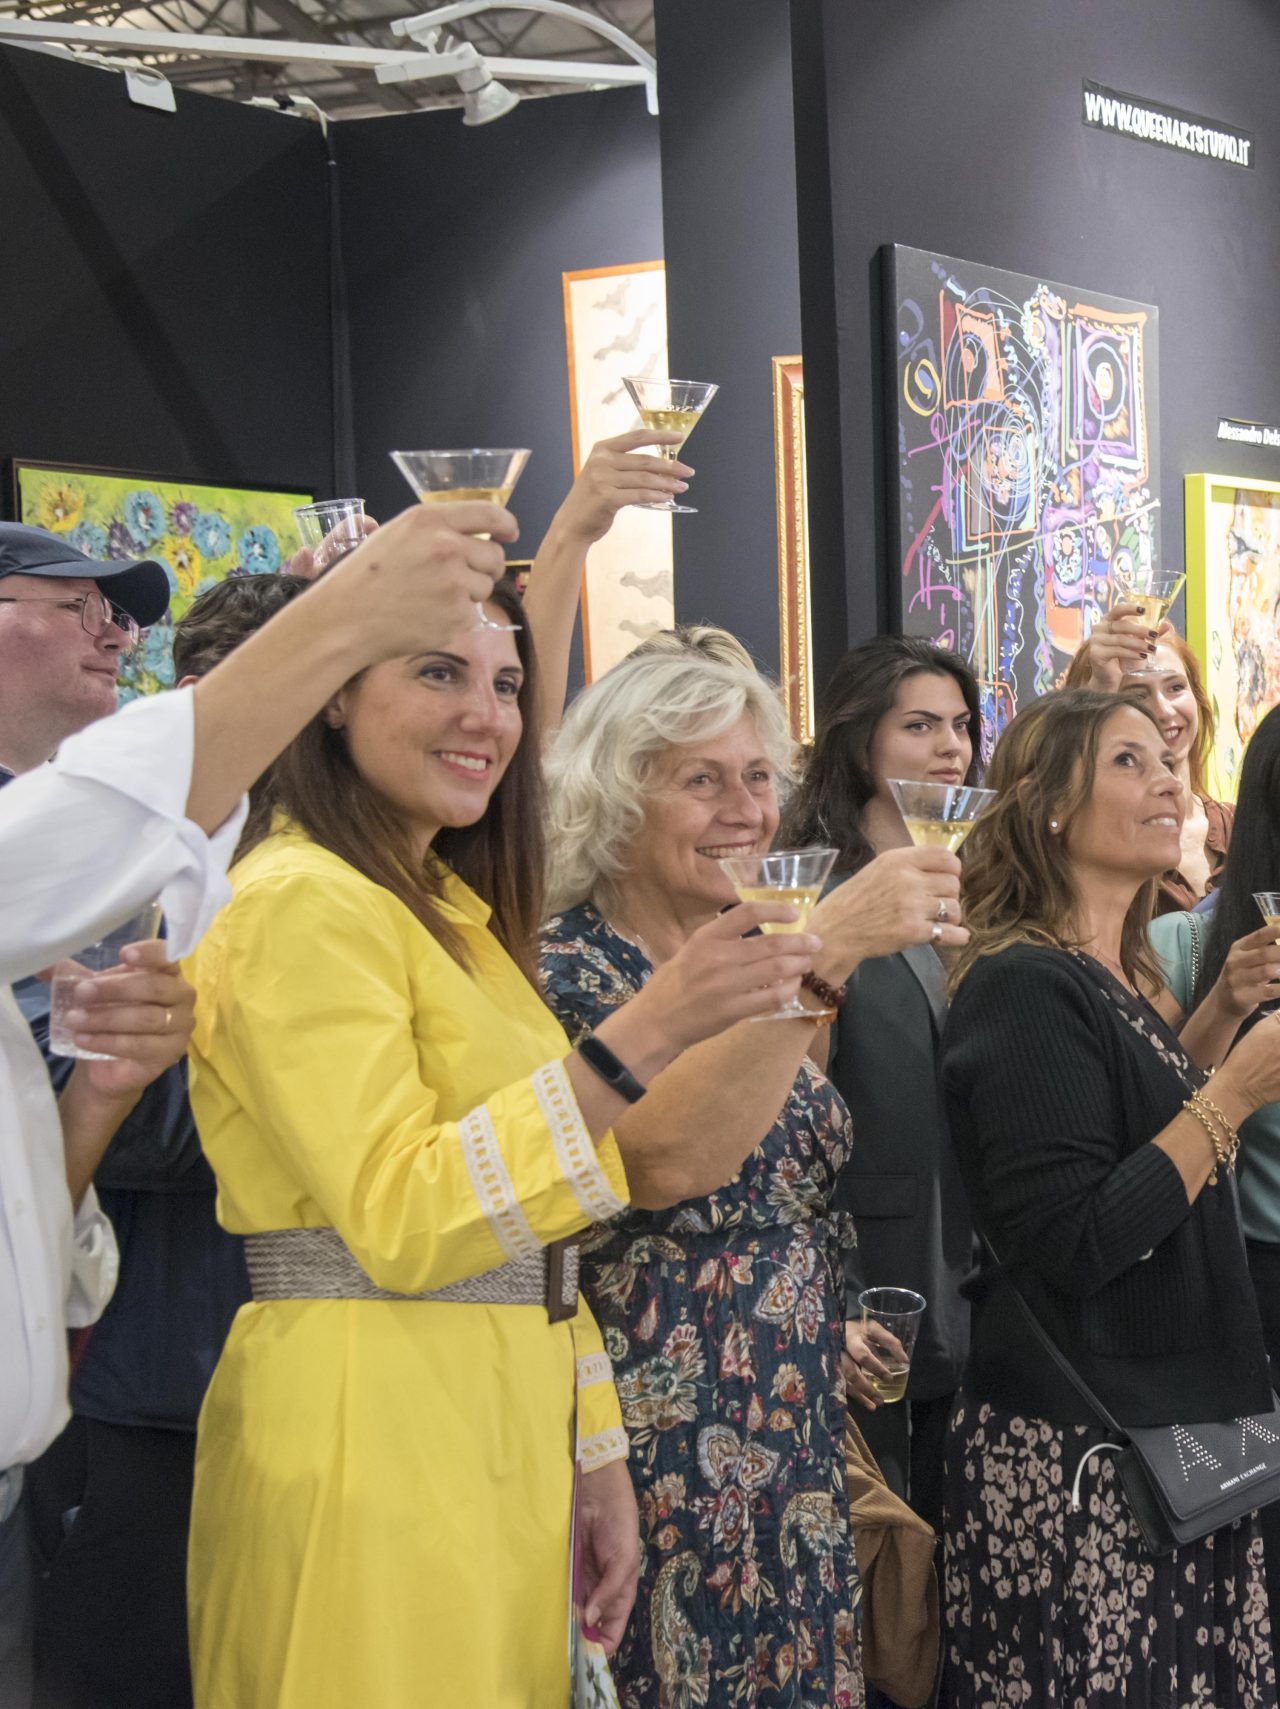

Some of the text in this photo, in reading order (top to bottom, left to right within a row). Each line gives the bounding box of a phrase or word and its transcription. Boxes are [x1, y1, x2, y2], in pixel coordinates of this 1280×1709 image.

[1084, 91, 1251, 167] WWW.QUEENARTSTUDIO.IT
[1217, 421, 1262, 444] Alessandro
[1220, 1462, 1267, 1490] ARMANI EXCHANGE
